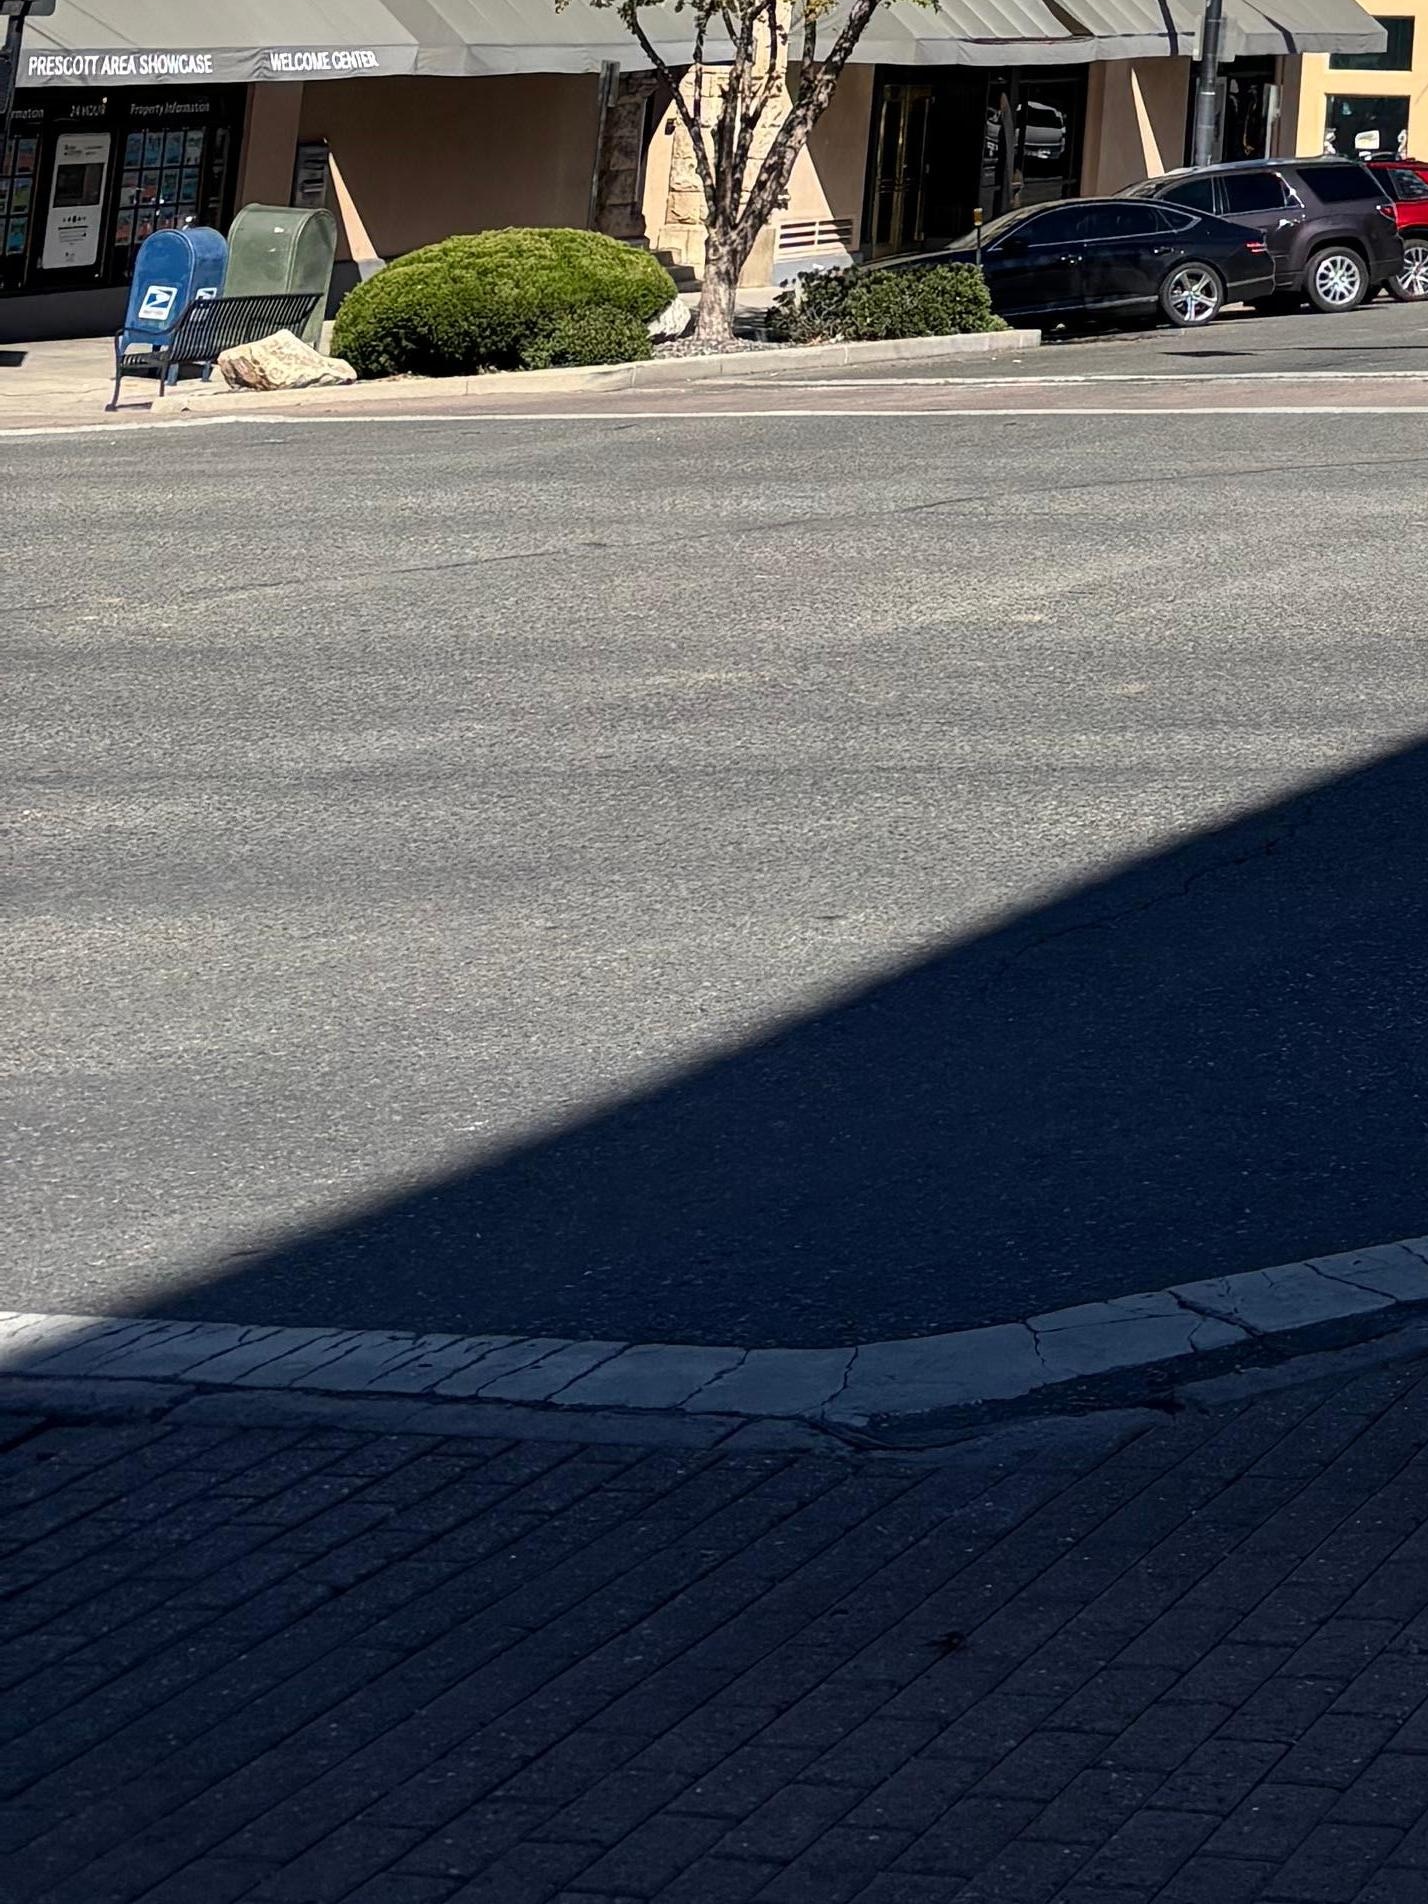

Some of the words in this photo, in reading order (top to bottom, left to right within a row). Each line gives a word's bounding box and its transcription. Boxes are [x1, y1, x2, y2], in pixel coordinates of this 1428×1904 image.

[28, 55, 100, 76] PRESCOTT
[101, 55, 137, 75] AREA
[139, 53, 214, 75] SHOWCASE
[270, 51, 331, 71] WELCOME
[332, 50, 380, 69] CENTER
